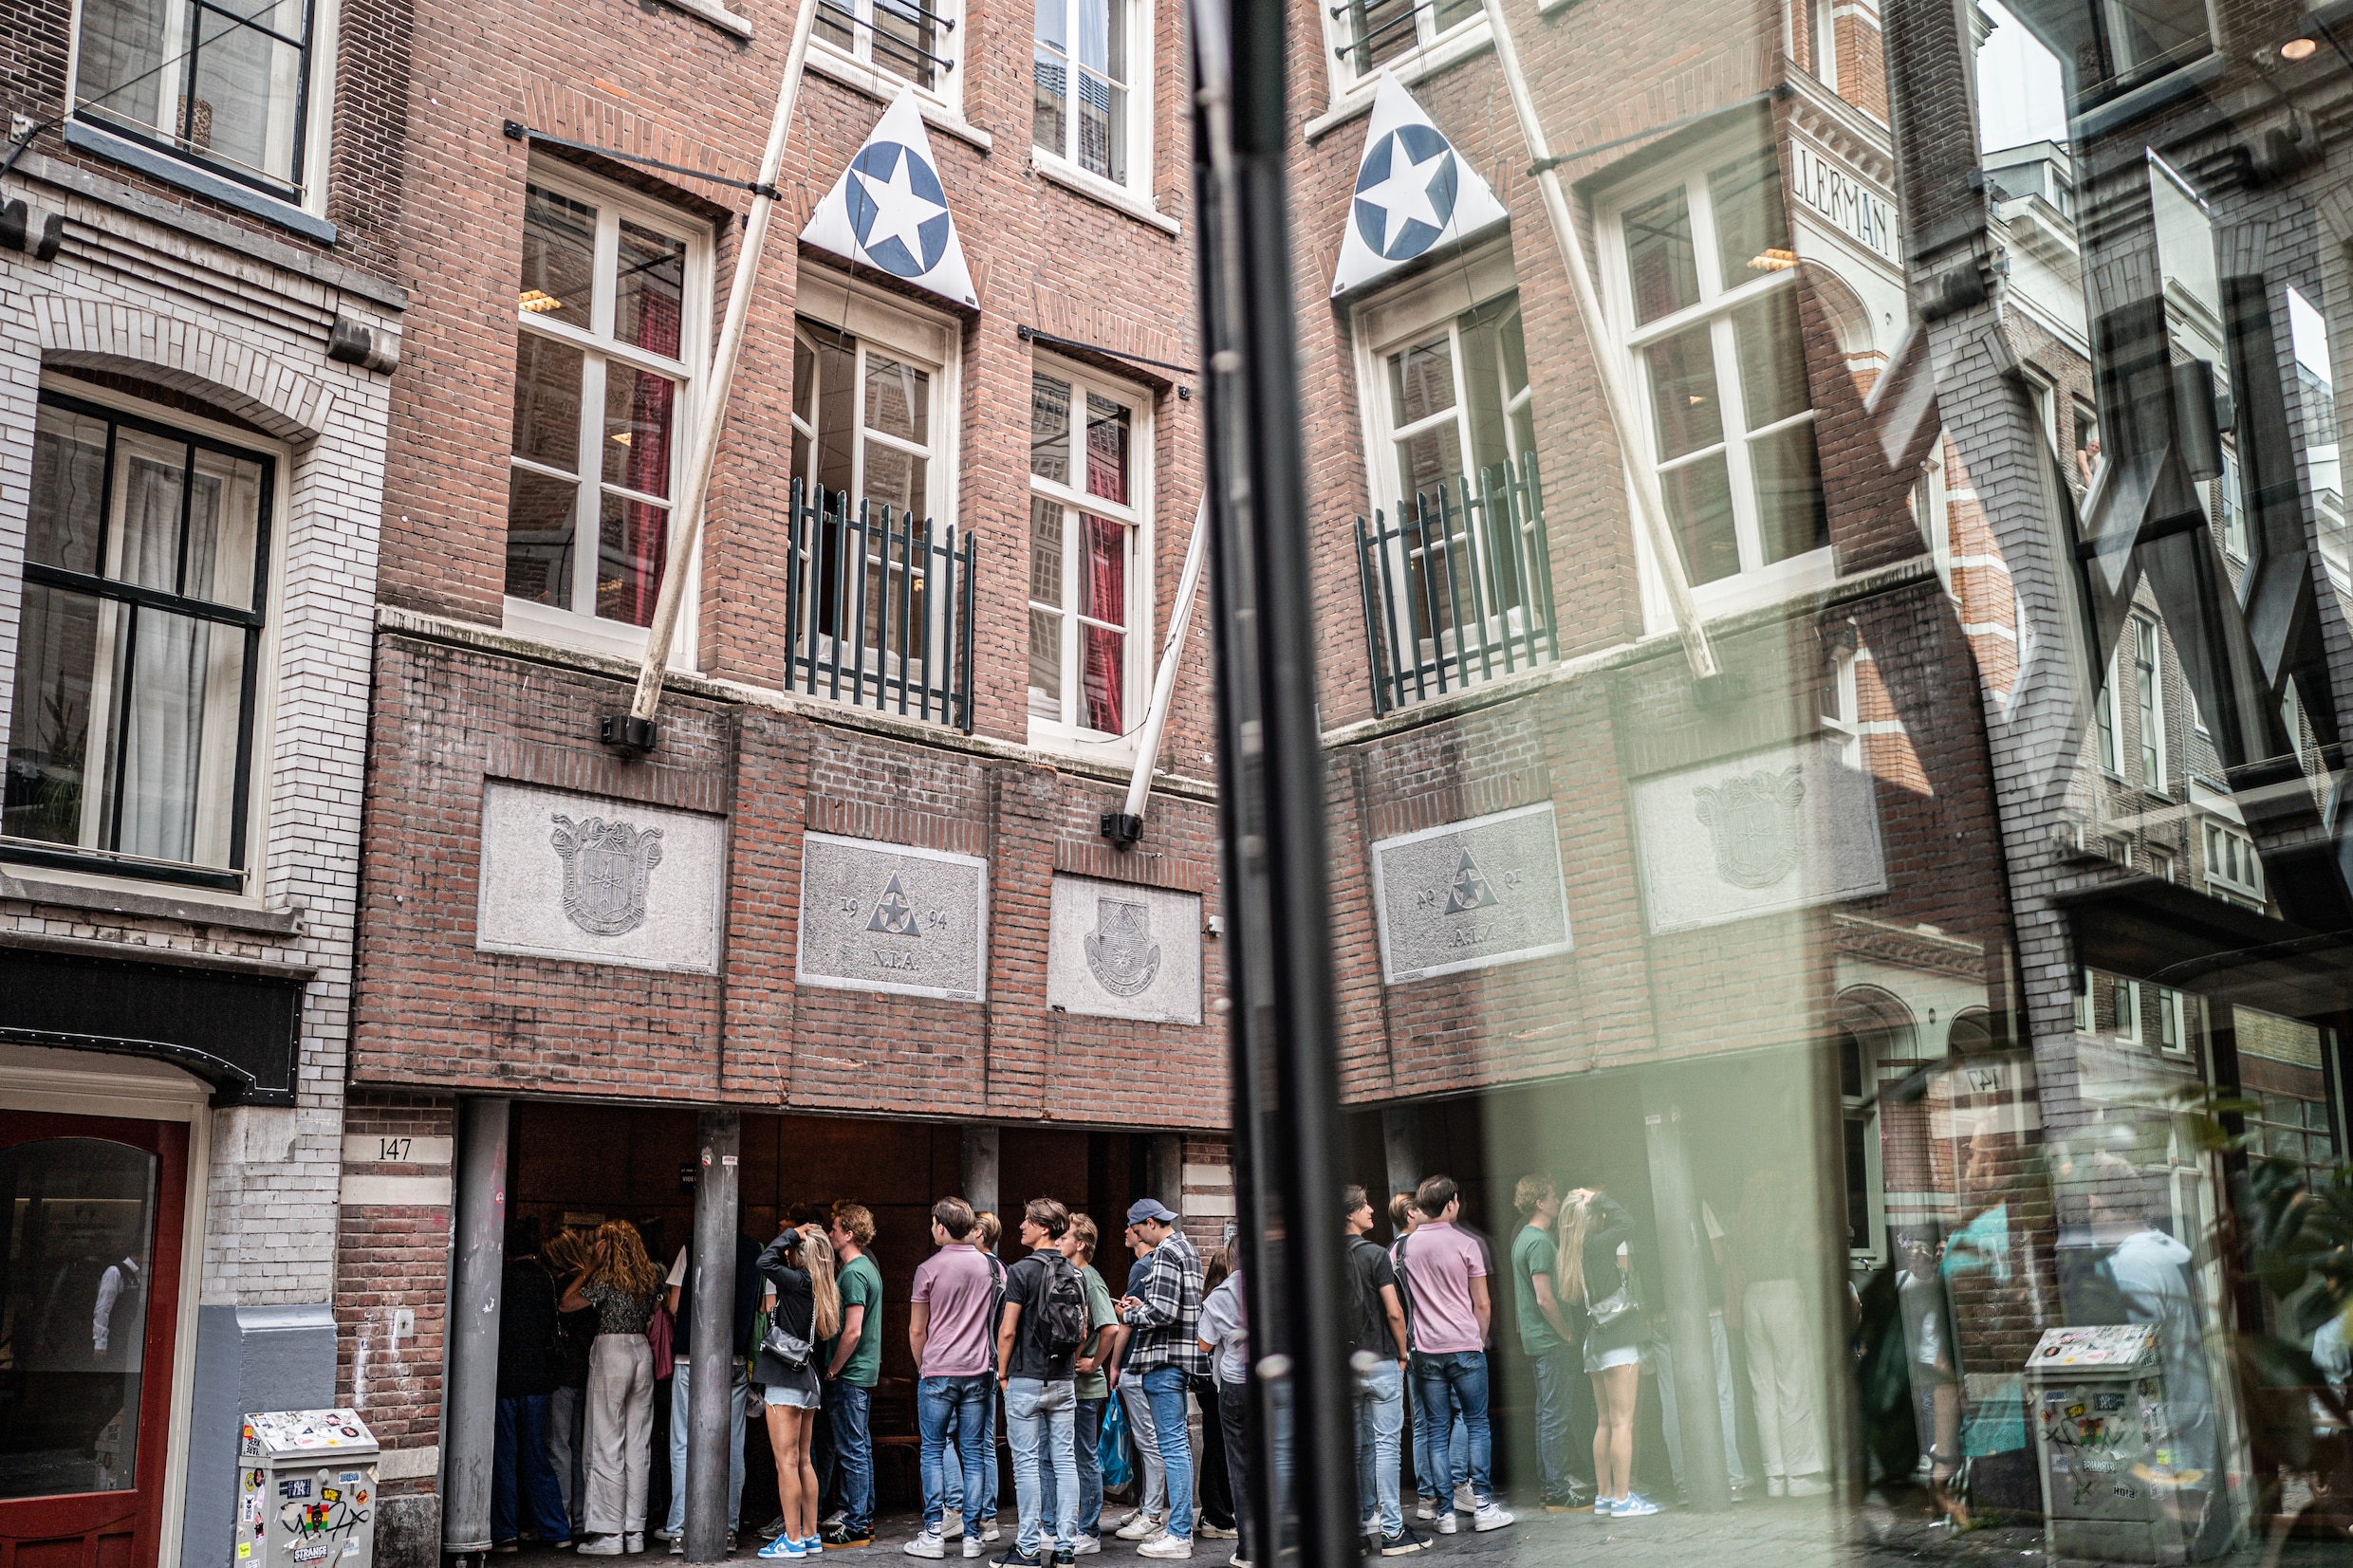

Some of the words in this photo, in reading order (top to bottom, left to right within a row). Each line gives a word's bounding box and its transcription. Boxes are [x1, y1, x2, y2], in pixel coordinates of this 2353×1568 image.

[841, 896, 859, 917] 19
[928, 911, 947, 930] 94
[871, 948, 919, 970] N.I.A.
[379, 1137, 412, 1160] 147
[295, 1546, 327, 1560] STRANGE
